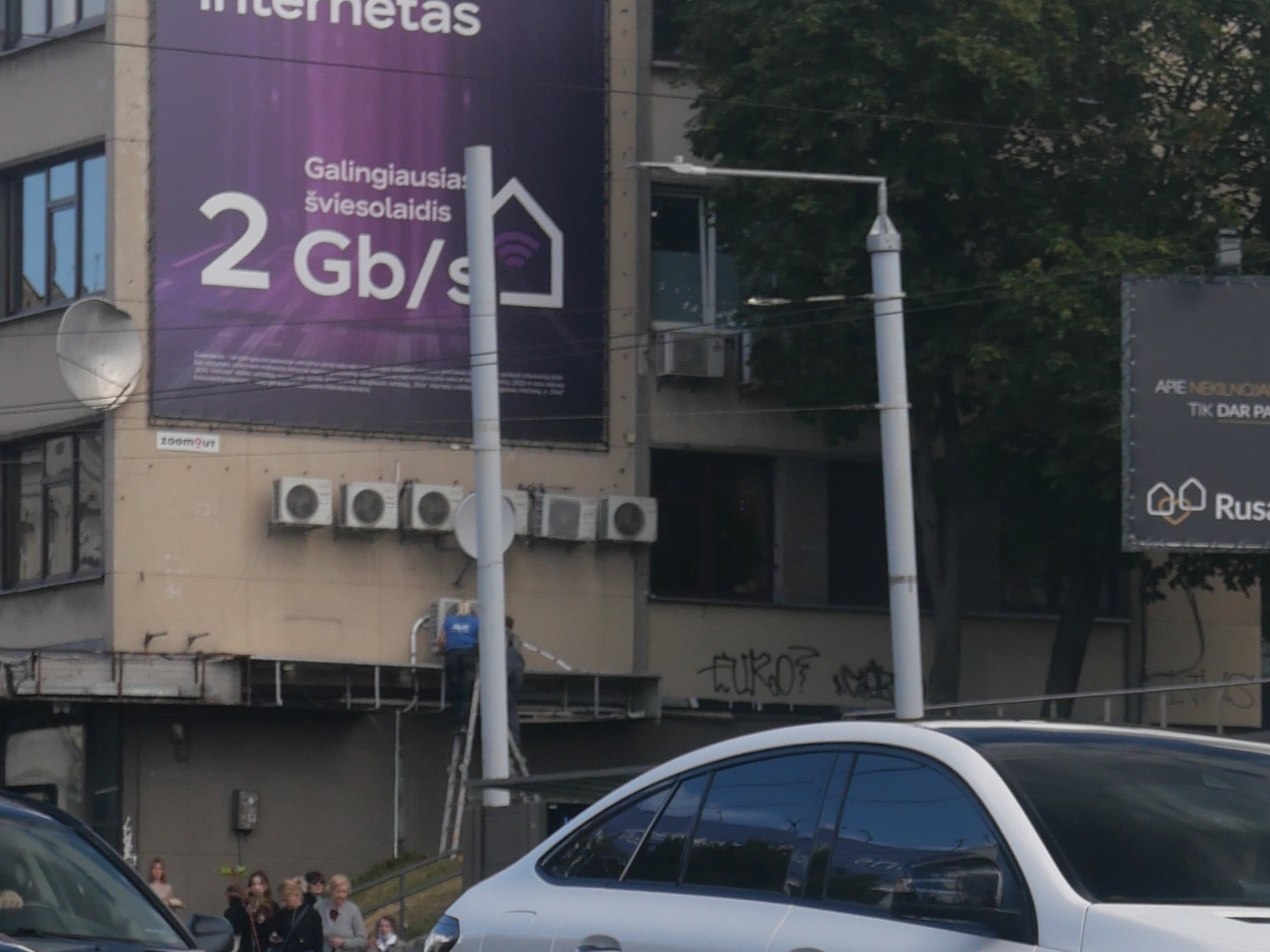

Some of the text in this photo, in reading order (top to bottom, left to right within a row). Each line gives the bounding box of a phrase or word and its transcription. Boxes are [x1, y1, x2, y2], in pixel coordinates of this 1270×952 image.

[200, 0, 481, 36] ernetas
[304, 191, 452, 223] šviesolaidis
[199, 191, 471, 309] 2 Gb/s
[1154, 379, 1188, 396] APIE
[1188, 401, 1214, 418] TIK
[1216, 402, 1251, 419] DAR
